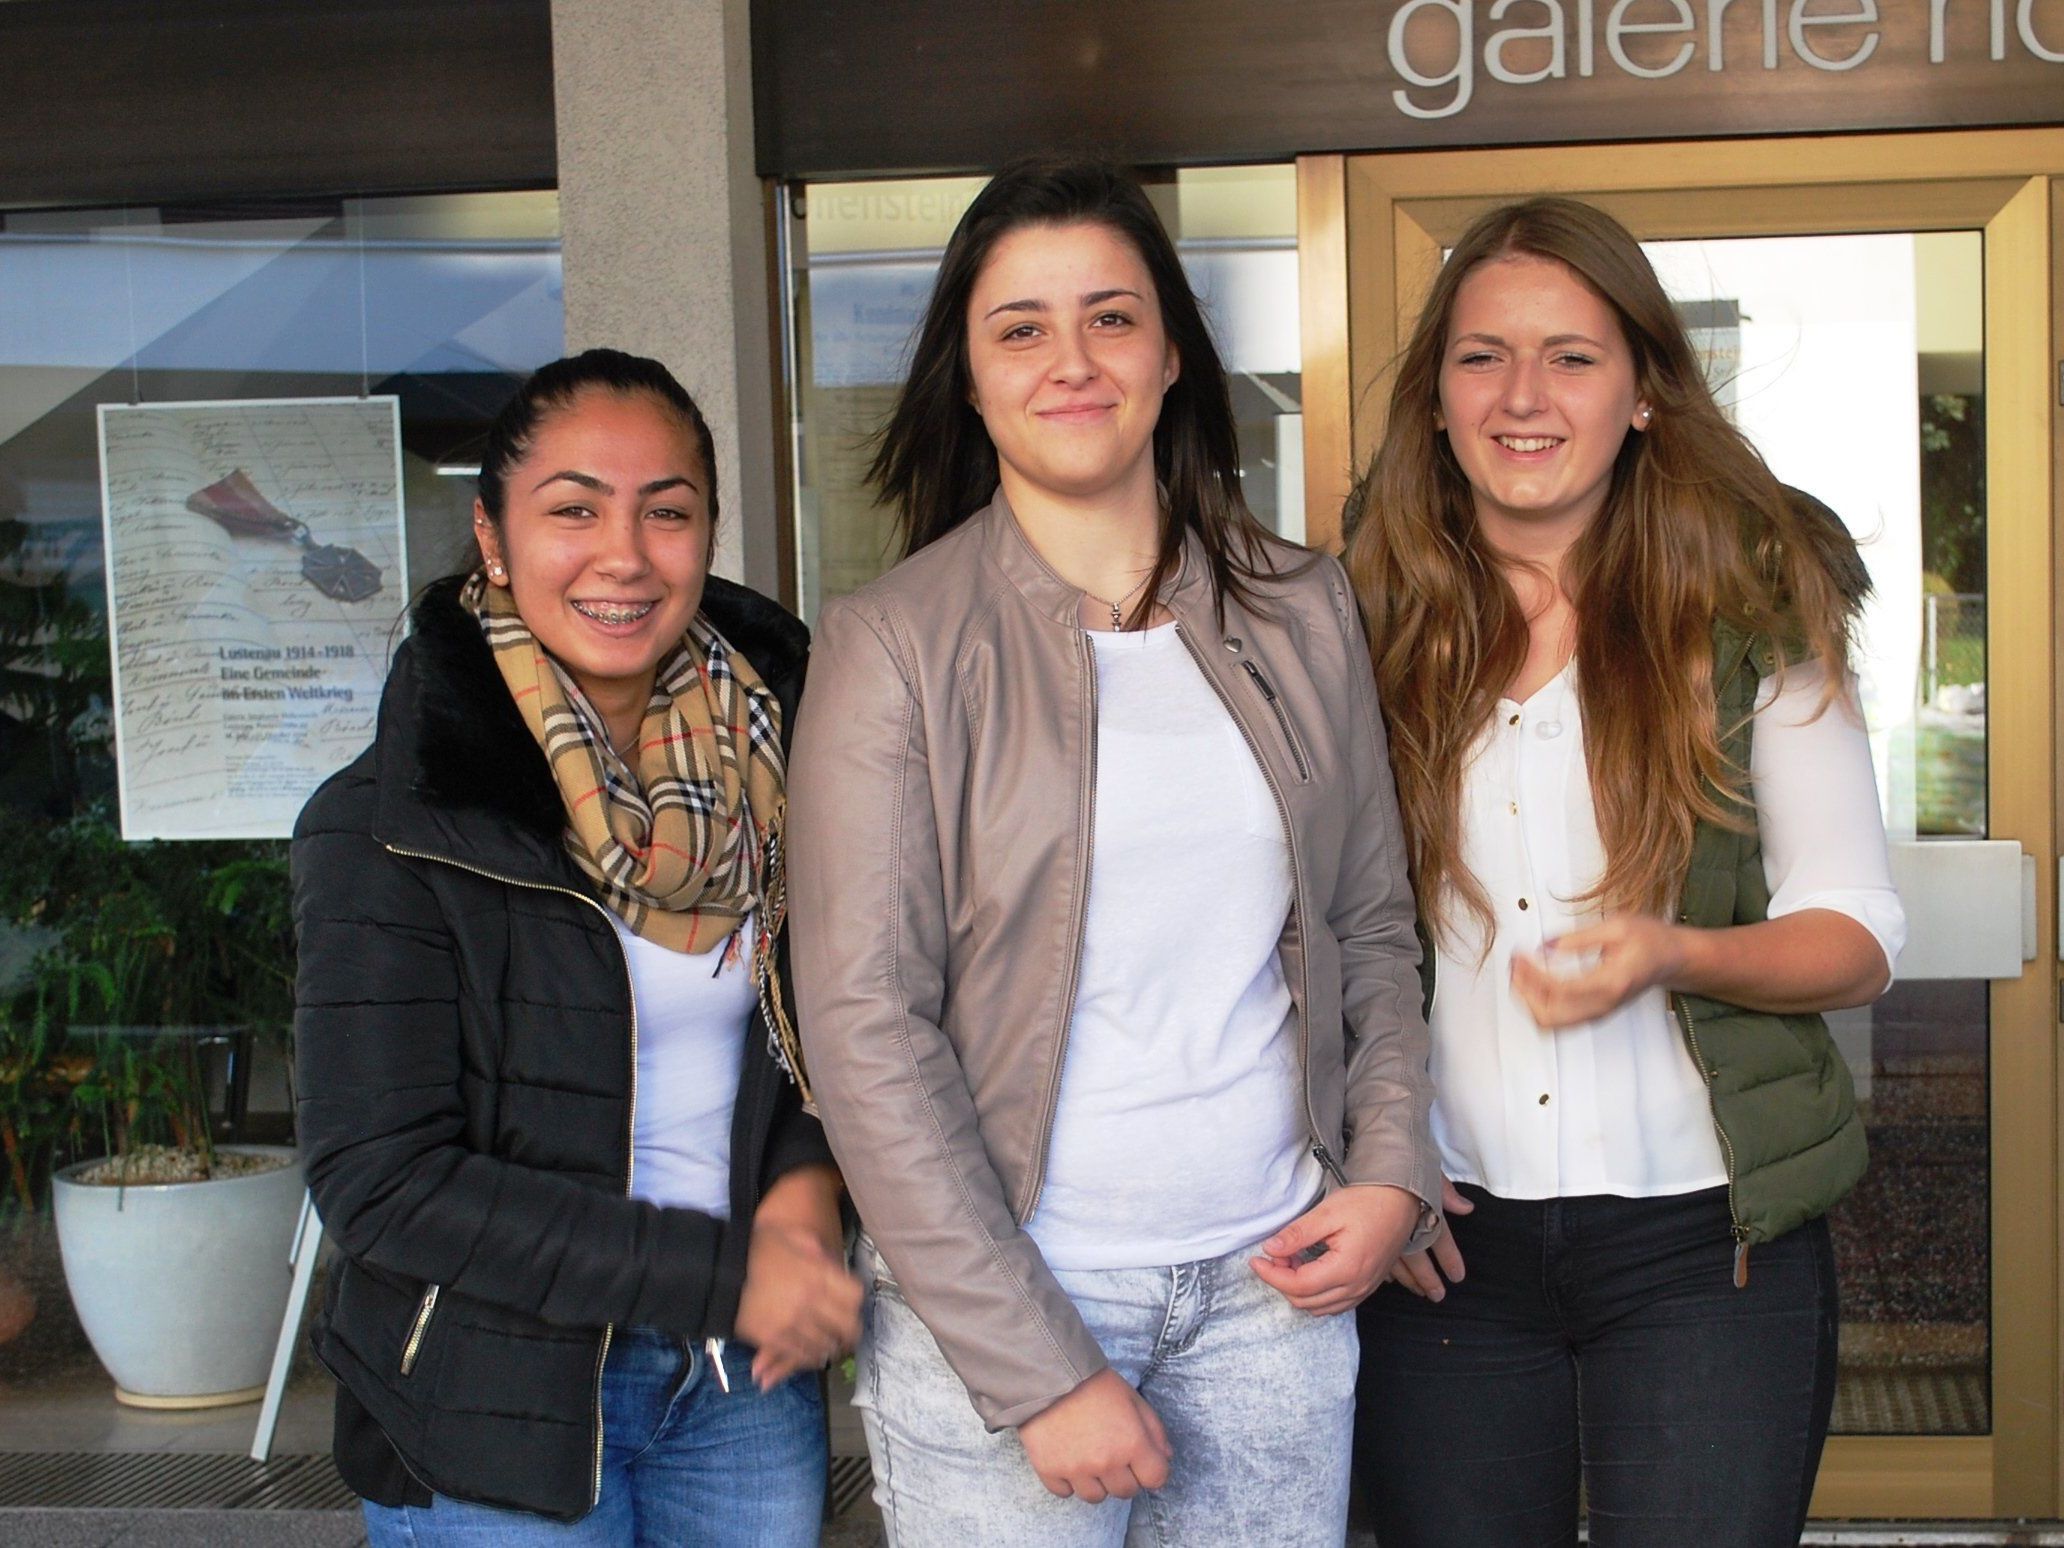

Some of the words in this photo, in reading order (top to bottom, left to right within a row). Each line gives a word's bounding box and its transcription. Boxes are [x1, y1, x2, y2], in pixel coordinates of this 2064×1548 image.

[1387, 0, 1881, 119] galerie
[219, 646, 281, 660] Lustenau
[220, 666, 250, 680] Eine
[253, 665, 321, 680] Gemeinde
[286, 685, 353, 702] Weltkrieg
